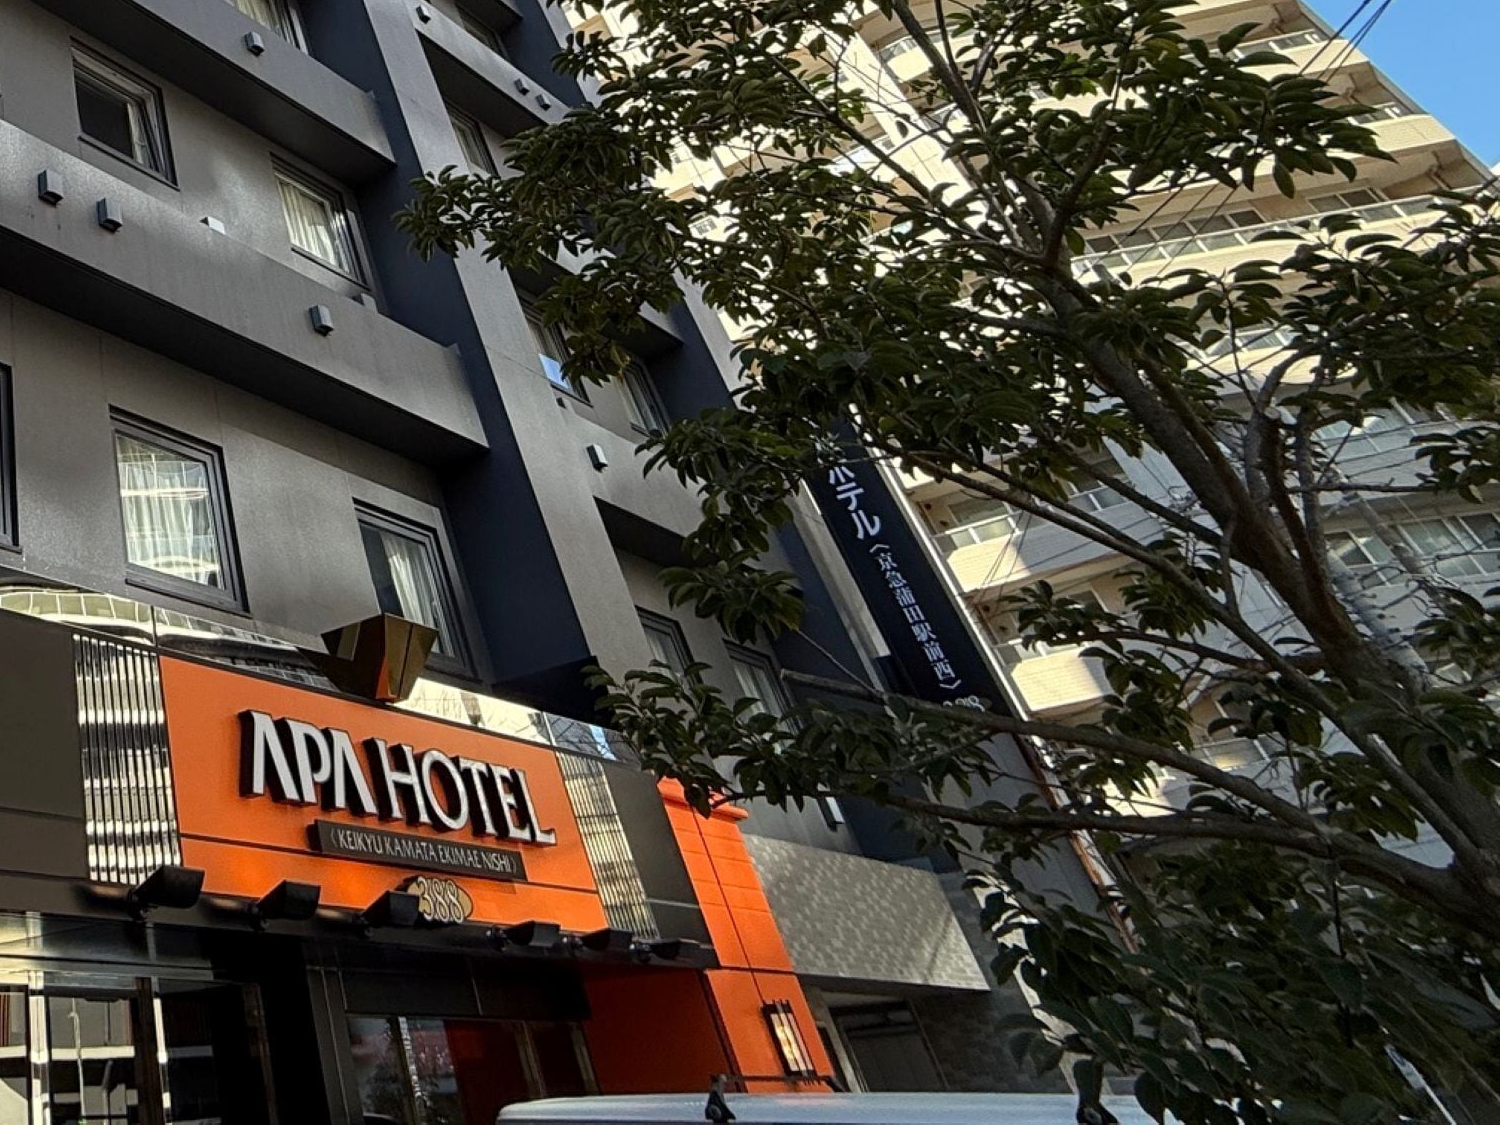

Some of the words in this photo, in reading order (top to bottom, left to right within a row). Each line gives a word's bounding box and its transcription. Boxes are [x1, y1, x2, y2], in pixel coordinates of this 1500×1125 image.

[239, 709, 378, 816] APA
[363, 736, 557, 846] HOTEL
[385, 837, 438, 863] KAMATA
[438, 844, 482, 869] EKIMAE
